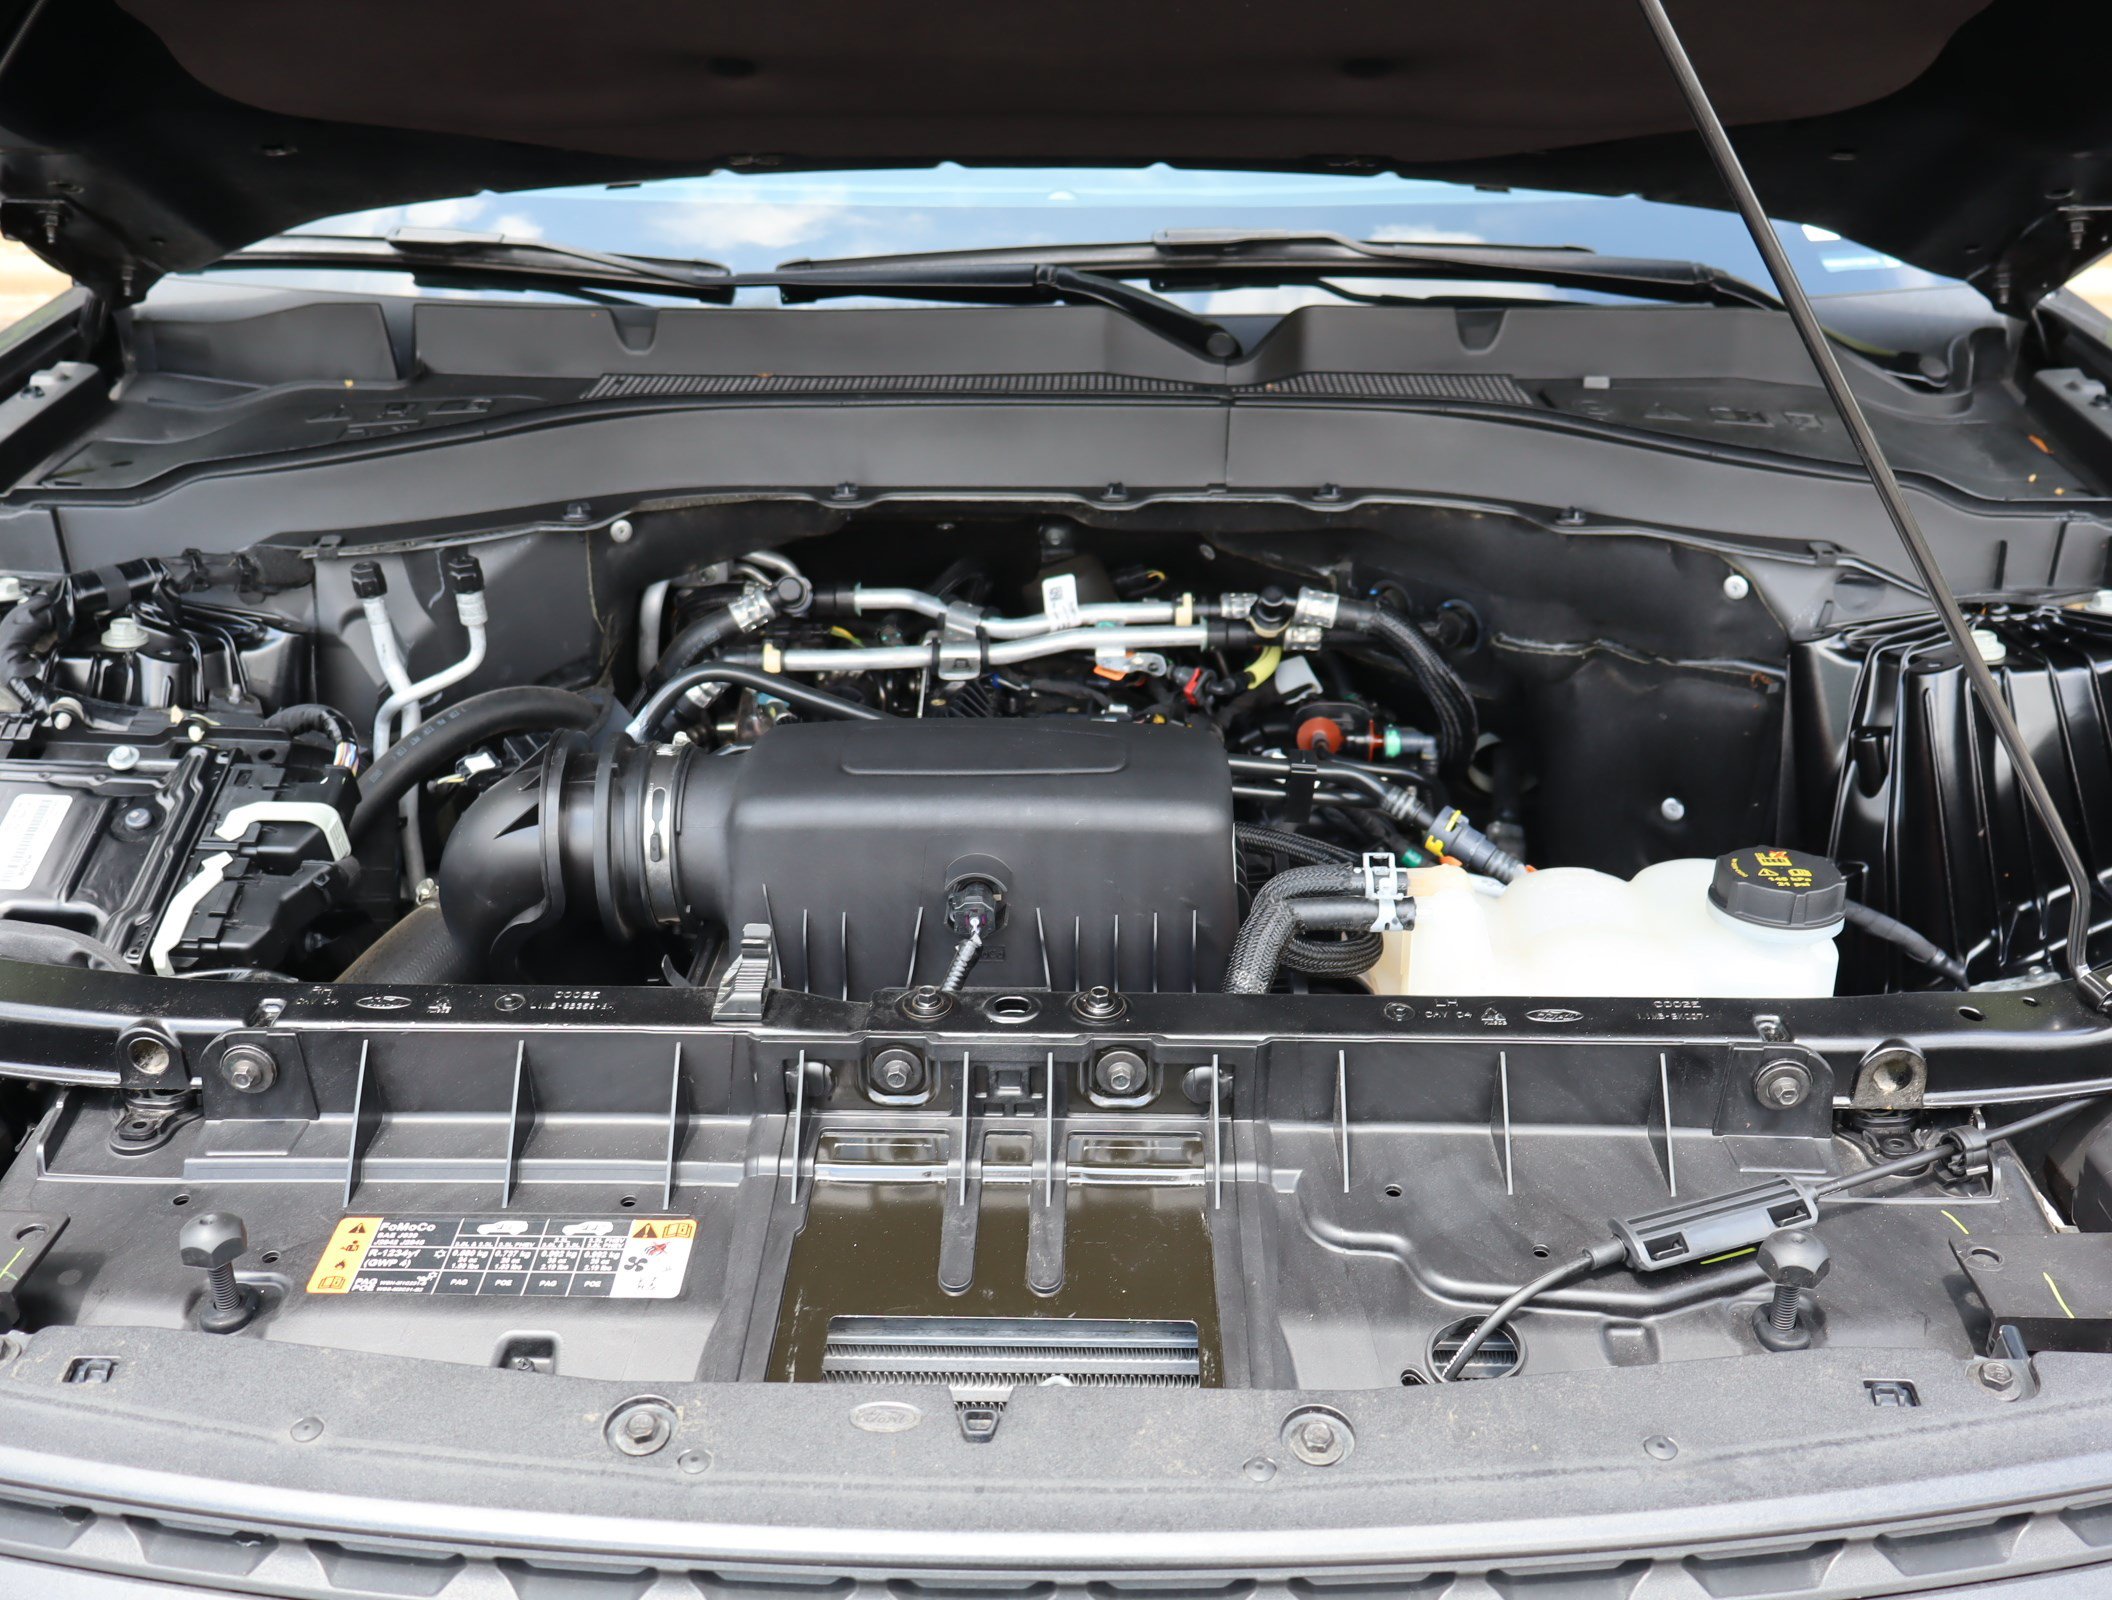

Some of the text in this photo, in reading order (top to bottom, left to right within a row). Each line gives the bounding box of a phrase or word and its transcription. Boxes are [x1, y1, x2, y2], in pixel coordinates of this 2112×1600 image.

[380, 1222, 436, 1232] FoMoCo
[368, 1249, 421, 1259] R-1234yf
[477, 1250, 489, 1259] kg
[519, 1251, 532, 1259] kg
[565, 1251, 578, 1259] kg
[608, 1252, 621, 1260] kg
[363, 1259, 411, 1269] (GWP 4)
